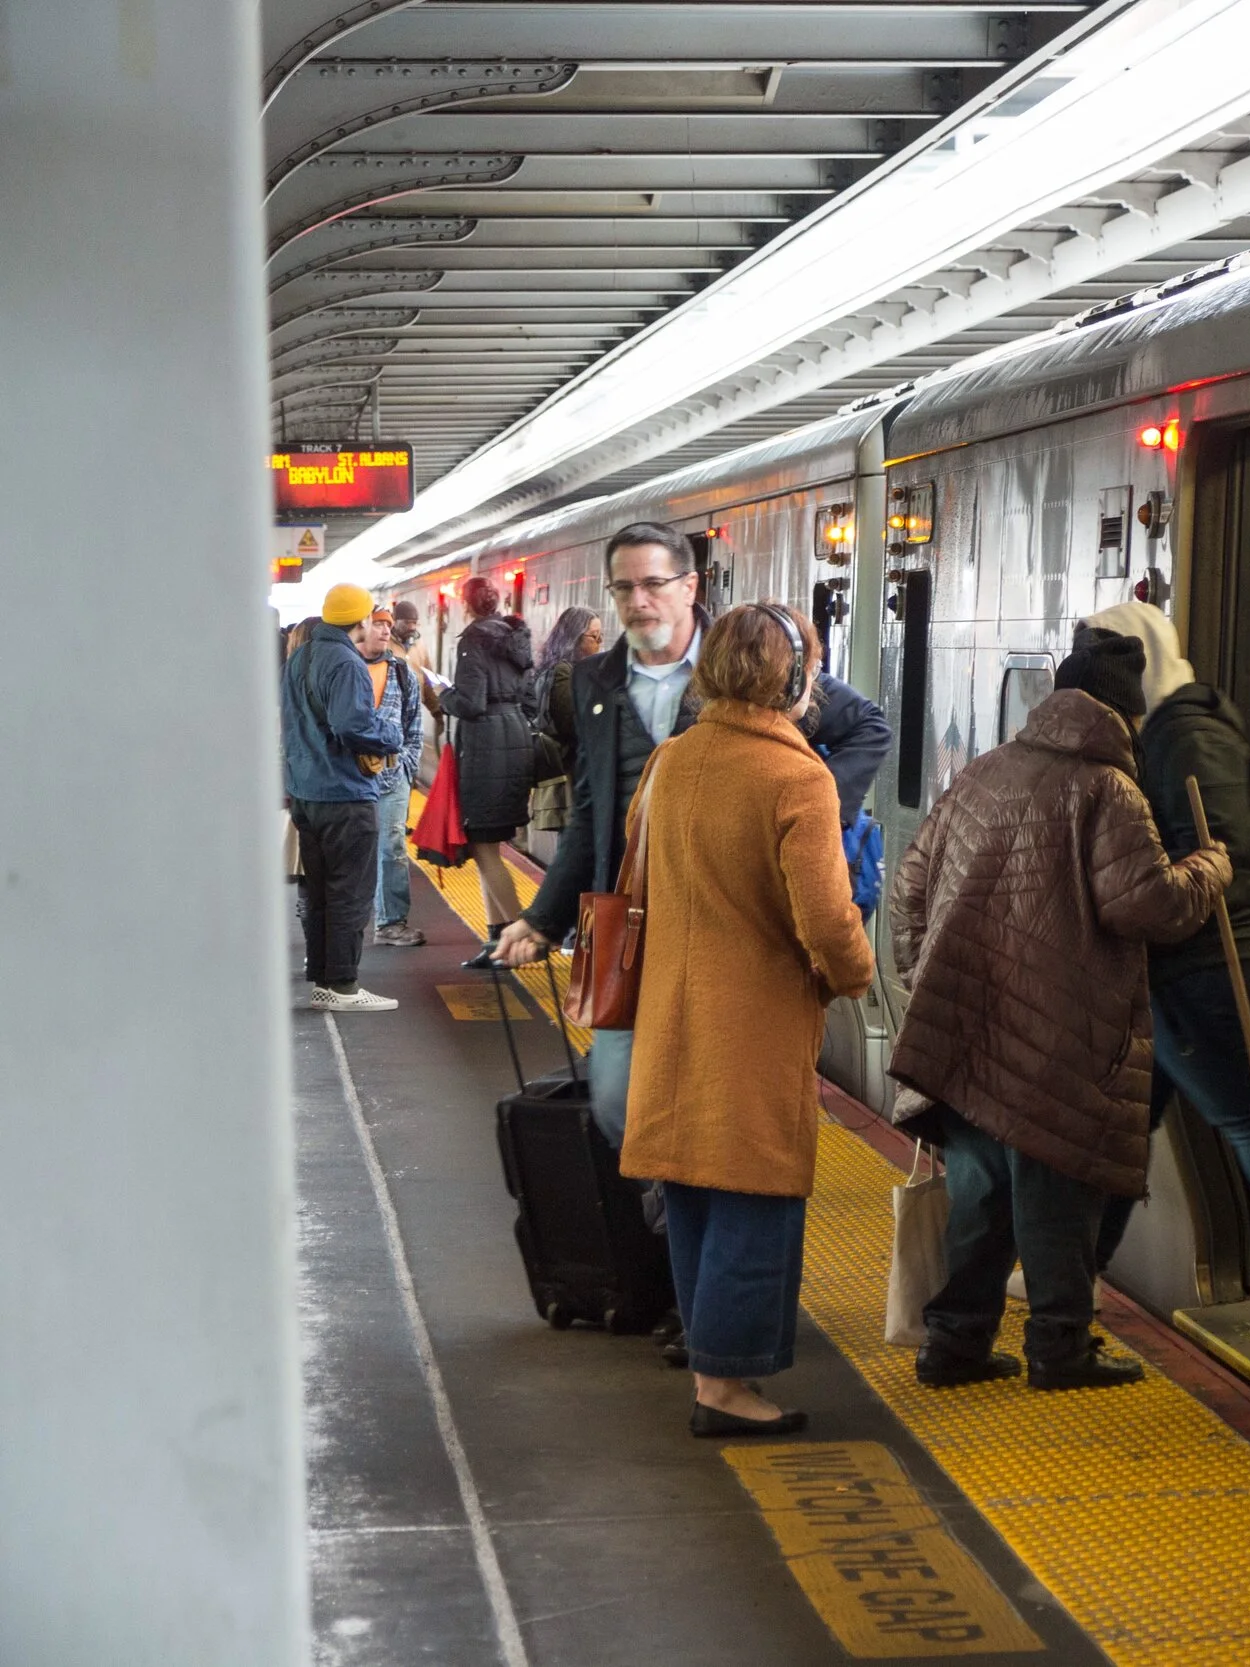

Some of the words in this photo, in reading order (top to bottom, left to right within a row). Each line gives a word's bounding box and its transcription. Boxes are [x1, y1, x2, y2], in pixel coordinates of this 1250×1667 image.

[301, 444, 332, 453] TRACK
[336, 444, 343, 452] 7
[337, 452, 358, 467] ST.
[359, 451, 409, 467] ALBANS
[288, 466, 355, 485] BABYLON
[766, 1450, 898, 1526] WATCH
[819, 1533, 940, 1582] THE
[858, 1589, 986, 1642] GAP
